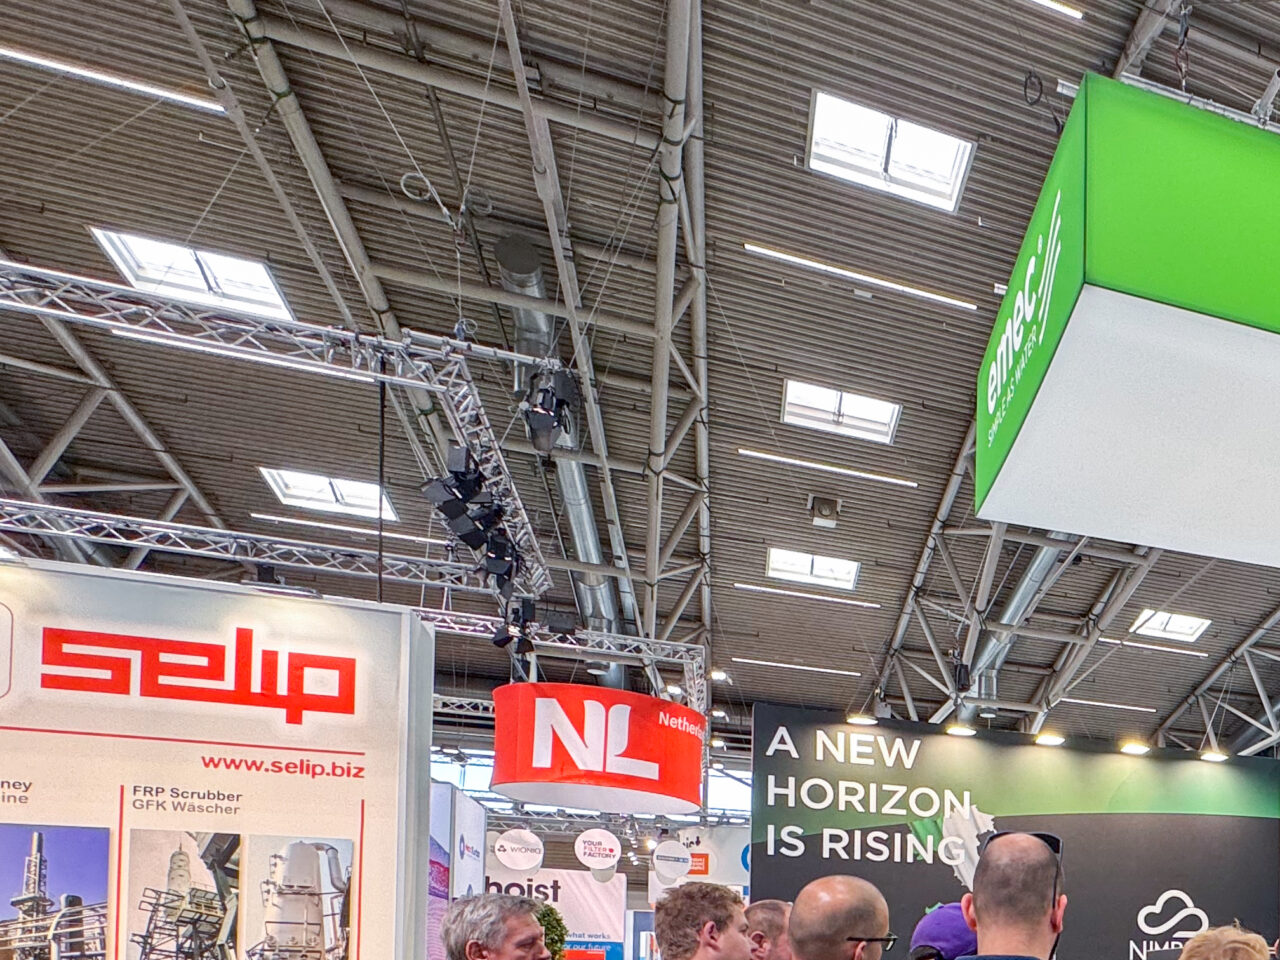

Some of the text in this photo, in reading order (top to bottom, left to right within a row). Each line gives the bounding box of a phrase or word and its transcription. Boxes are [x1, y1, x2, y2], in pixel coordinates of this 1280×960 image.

[987, 255, 1036, 415] emec
[1014, 324, 1037, 385] WATER
[41, 627, 356, 725] selip
[532, 697, 659, 781] NL
[765, 726, 921, 769] A NEW
[201, 755, 365, 780] www.selip.biz
[132, 785, 243, 802] FRP Scrubber
[132, 798, 241, 815] GFK Wäscher
[767, 774, 971, 820] HORIZON
[582, 839, 603, 847] YOUR
[766, 824, 966, 866] IS RISING
[485, 876, 561, 902] hoist
